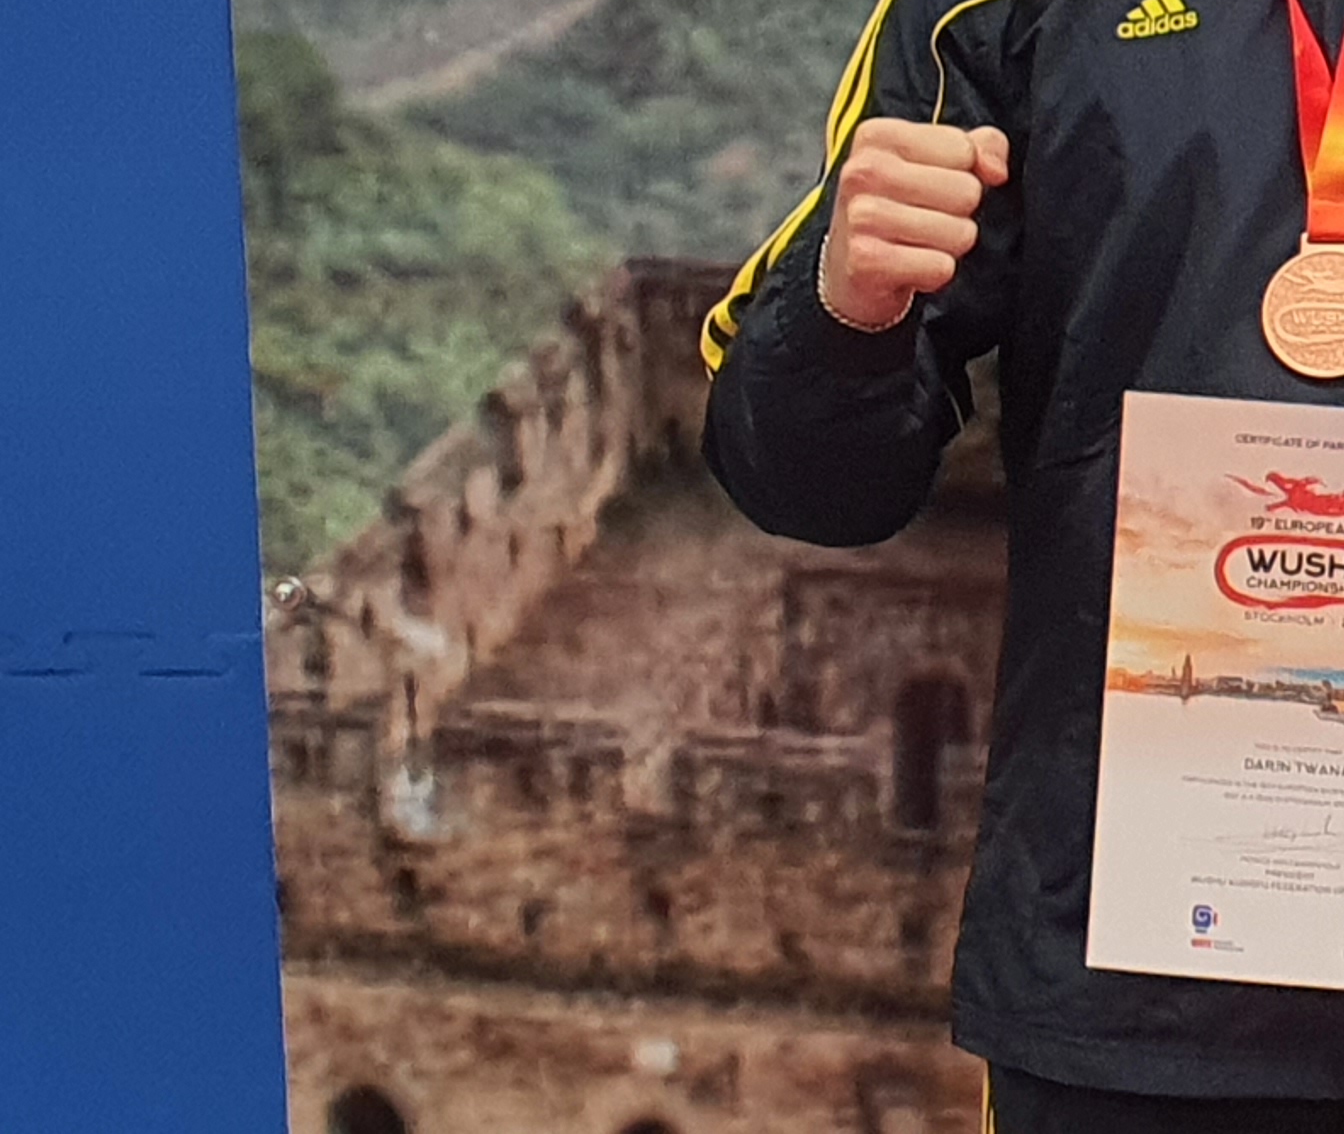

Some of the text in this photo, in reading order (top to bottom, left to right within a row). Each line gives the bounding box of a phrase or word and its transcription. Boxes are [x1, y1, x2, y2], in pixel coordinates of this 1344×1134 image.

[1117, 11, 1198, 39] adidas
[1235, 433, 1301, 448] CERTIFICATE
[1306, 439, 1320, 449] OF
[1244, 611, 1324, 625] STOCKHOLM
[1244, 758, 1291, 773] DARIN
